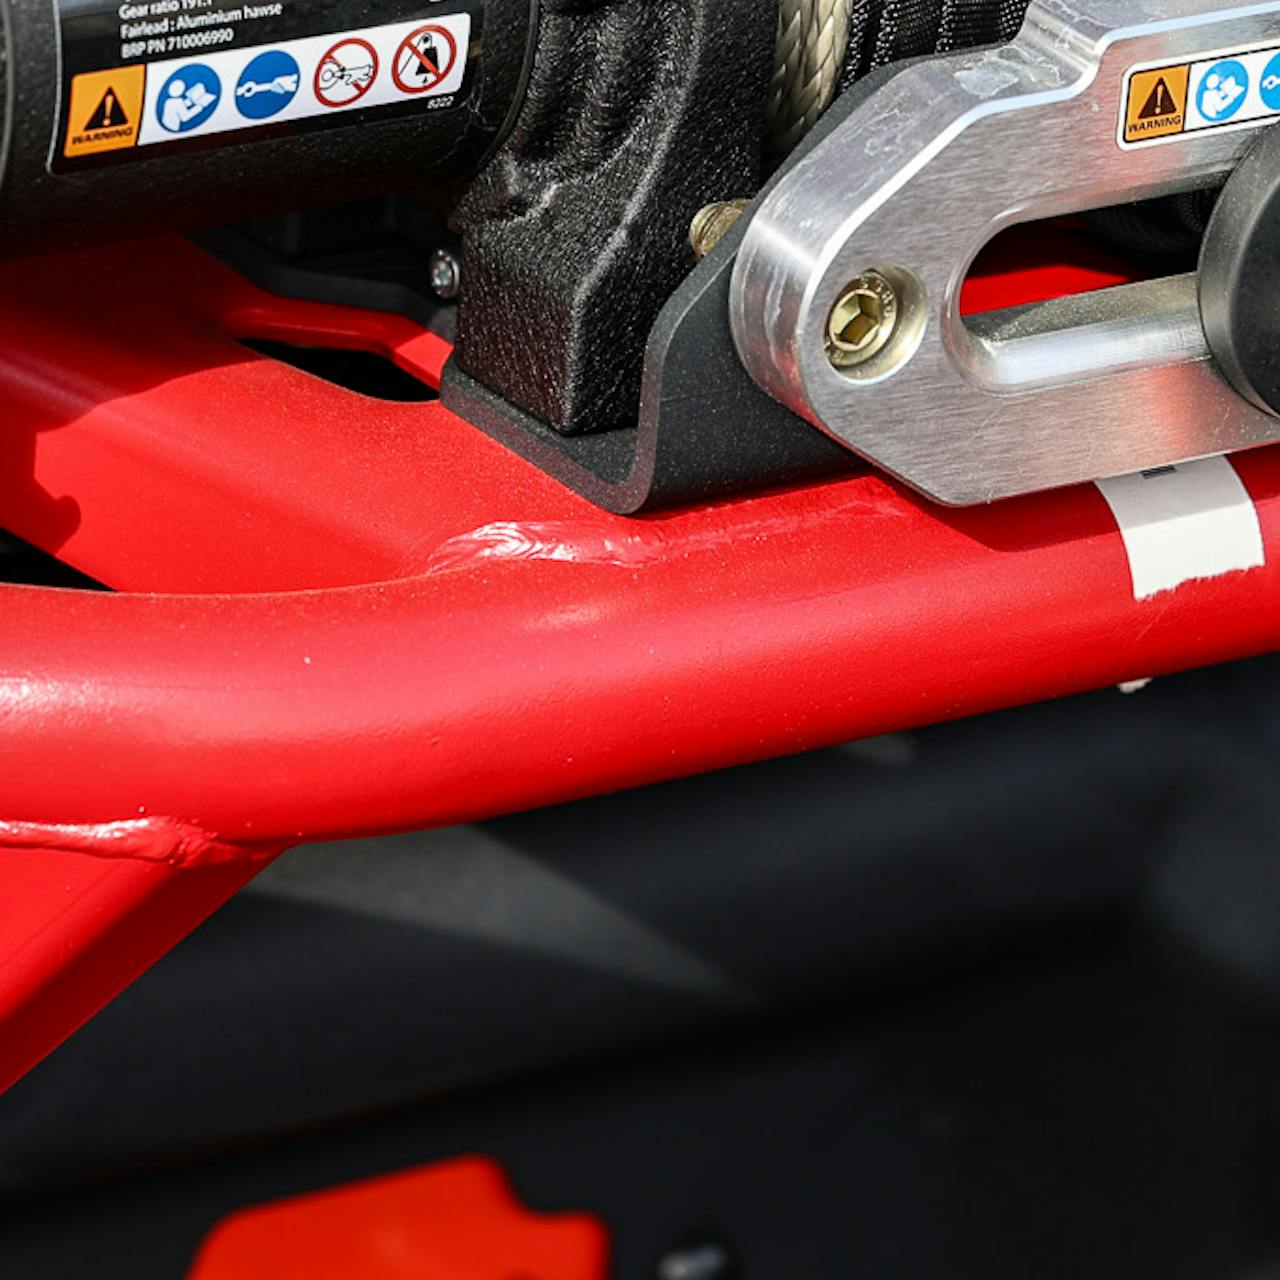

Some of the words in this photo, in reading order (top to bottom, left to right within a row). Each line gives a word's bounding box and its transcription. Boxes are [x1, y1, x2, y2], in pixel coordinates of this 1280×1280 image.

[119, 4, 148, 19] Gear
[121, 17, 169, 39] Fairlead
[176, 10, 242, 30] Aluminium
[243, 3, 283, 20] hawse
[121, 41, 147, 60] BRP
[147, 38, 166, 54] PN
[167, 27, 234, 51] 710006990
[1128, 115, 1181, 132] WARNING
[72, 126, 133, 145] WARNING
